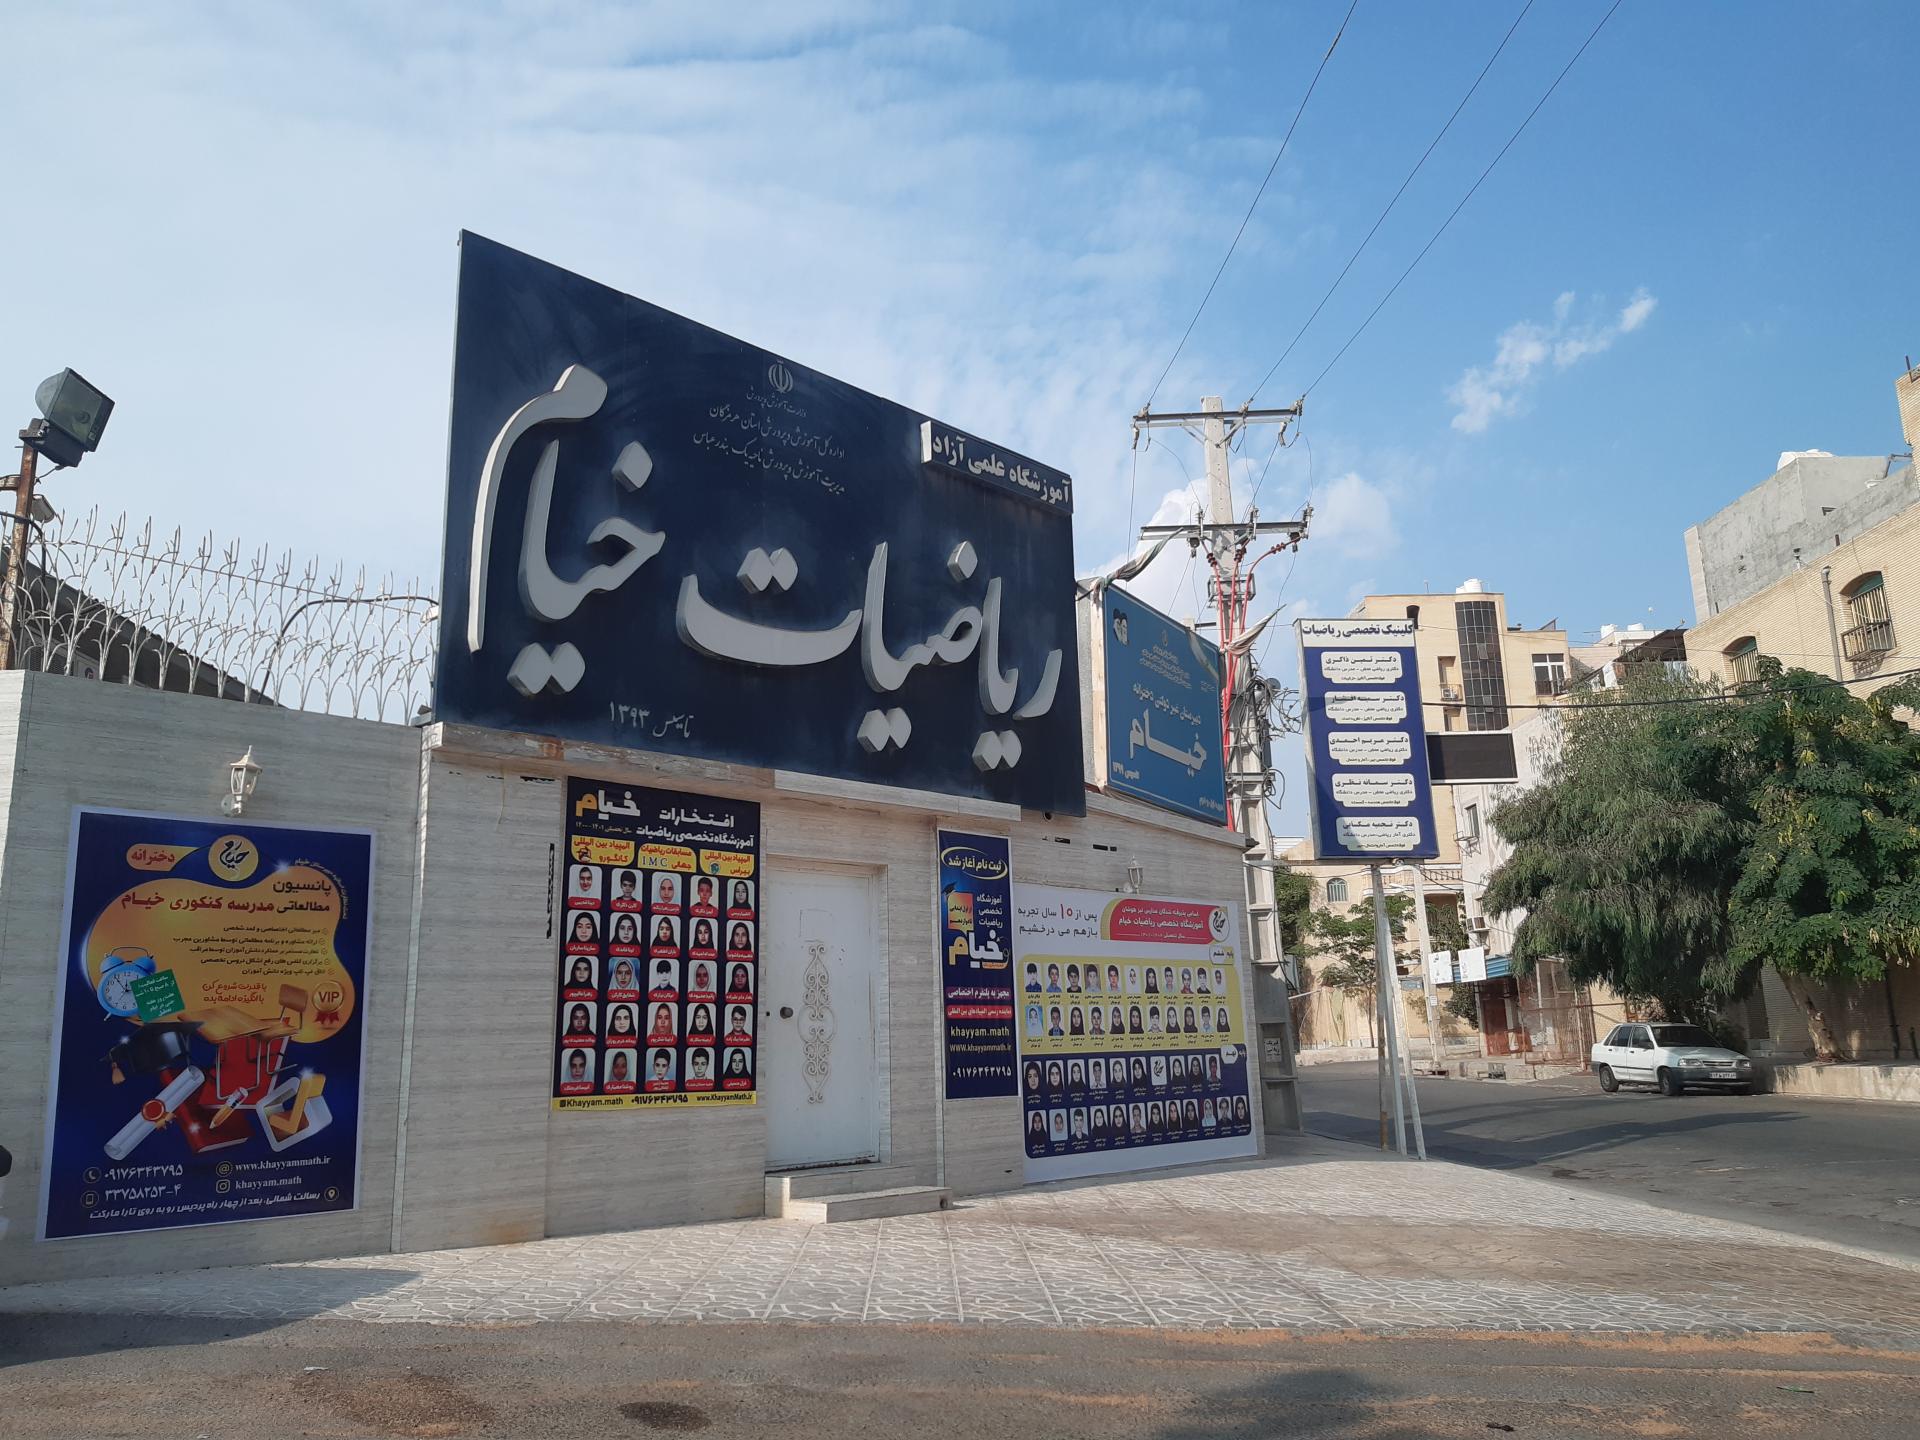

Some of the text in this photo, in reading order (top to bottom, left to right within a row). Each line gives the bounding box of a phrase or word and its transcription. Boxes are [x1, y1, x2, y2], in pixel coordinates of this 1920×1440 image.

[709, 404, 740, 423] هرمزگان
[740, 413, 760, 430] استان
[760, 416, 788, 446] پرورش
[790, 427, 820, 448] آموزش
[693, 431, 716, 450] عباس
[715, 438, 730, 455] بندر
[817, 435, 833, 457] کل
[761, 449, 789, 480] پرورش
[792, 459, 822, 482] آموزش
[932, 436, 1071, 505] آموزشگاه علمی آزاد
[820, 477, 845, 494] مدیریت
[467, 363, 667, 698] خیام
[1302, 624, 1413, 638] کلینیک تخصصی ریاضیات
[676, 540, 1063, 773] ریاضیات
[1326, 656, 1397, 665] دکتر ذاکری
[1380, 695, 1404, 703] دکتر
[609, 701, 650, 729] ۱۳۹۳
[1129, 708, 1208, 777] خیام
[1329, 736, 1409, 745] دکتر مریم احمدی
[1389, 778, 1413, 787] دکتر
[575, 789, 641, 820] خیام
[659, 807, 735, 828] افتخارات
[1396, 820, 1413, 829] دکتر
[573, 837, 631, 851] المپیاد بین المللی
[635, 825, 755, 849] آموزشگاه تخصصی ریاضیات
[131, 848, 175, 866] دخترانه
[640, 844, 693, 858] مسابقات ریاضیات
[948, 855, 1002, 874] ثبت نام آغاز شد
[272, 879, 332, 897] پانسیون
[121, 892, 330, 914] مطالعاتی مدرسه کنکوری خیام
[976, 893, 1003, 905] آموزشگاه
[978, 906, 1003, 916] تخصصی
[1017, 903, 1098, 923] پس از ۱۵ سال تجربه
[978, 917, 1004, 929] ریاضیات
[1118, 914, 1204, 930] آموزشگاه تخصصی ریاضیات خیام
[1019, 923, 1055, 937] درخشیم
[1057, 928, 1071, 937] می
[948, 929, 1004, 969] خیام
[317, 991, 340, 1003] VIP
[948, 987, 1010, 1000] مجهز به پلتفرم اختصاصی
[950, 1026, 1010, 1039] khayyam.math
[952, 1066, 1012, 1078] ۰۹۱۷۶۳۴۳۷۹۵
[567, 1097, 624, 1108] Khayyam.math
[235, 1156, 332, 1171] www.khayyammath.ir
[235, 1176, 302, 1190] khayyam.math
[293, 1191, 321, 1201] رسالت
[89, 1208, 120, 1219] مارکت
[121, 1207, 137, 1217] تارا
[137, 1207, 155, 1217] روی
[177, 1202, 206, 1213] پردیس
